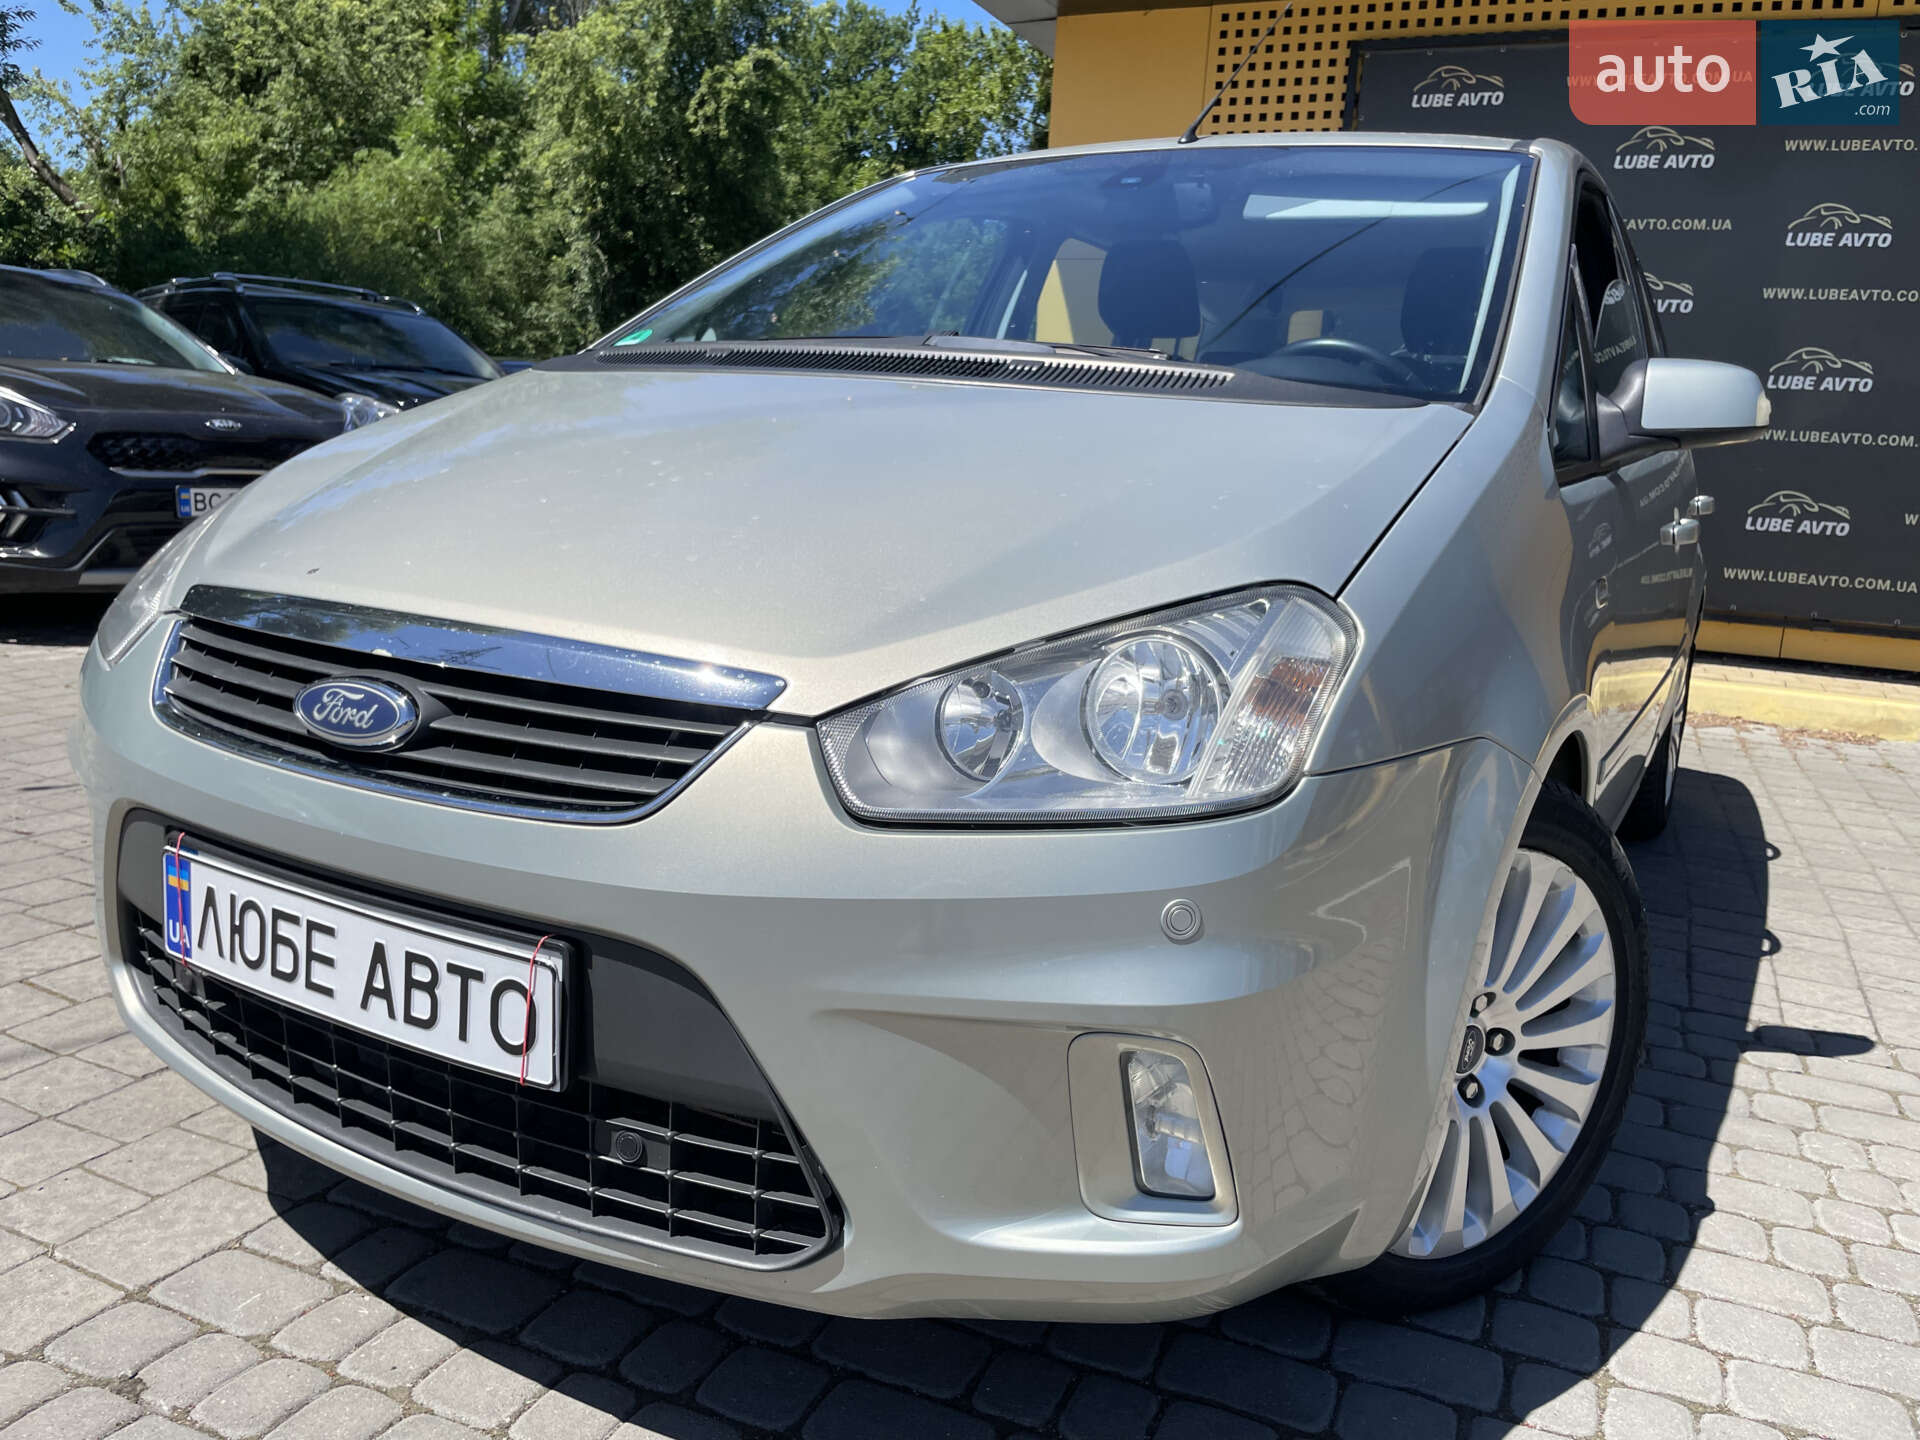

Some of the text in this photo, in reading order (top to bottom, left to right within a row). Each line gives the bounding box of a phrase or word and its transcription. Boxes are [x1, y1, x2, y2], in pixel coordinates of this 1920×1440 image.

[1411, 91, 1505, 108] LUBE AVTO
[1613, 153, 1716, 170] LUBE AVTO
[1623, 218, 1733, 231] AVTO.COM.UA
[1785, 231, 1893, 248] LUBE AVTO
[1653, 298, 1694, 314] VTO
[1766, 374, 1874, 393] LUBE AVTO
[1744, 516, 1850, 537] LUBE AVTO
[1723, 566, 1919, 594] WWW.LUBEAVTO.COM.UA
[312, 687, 379, 729] Ford
[168, 919, 191, 949] UA
[197, 884, 538, 1056] ЛЮБЕ АВТО
